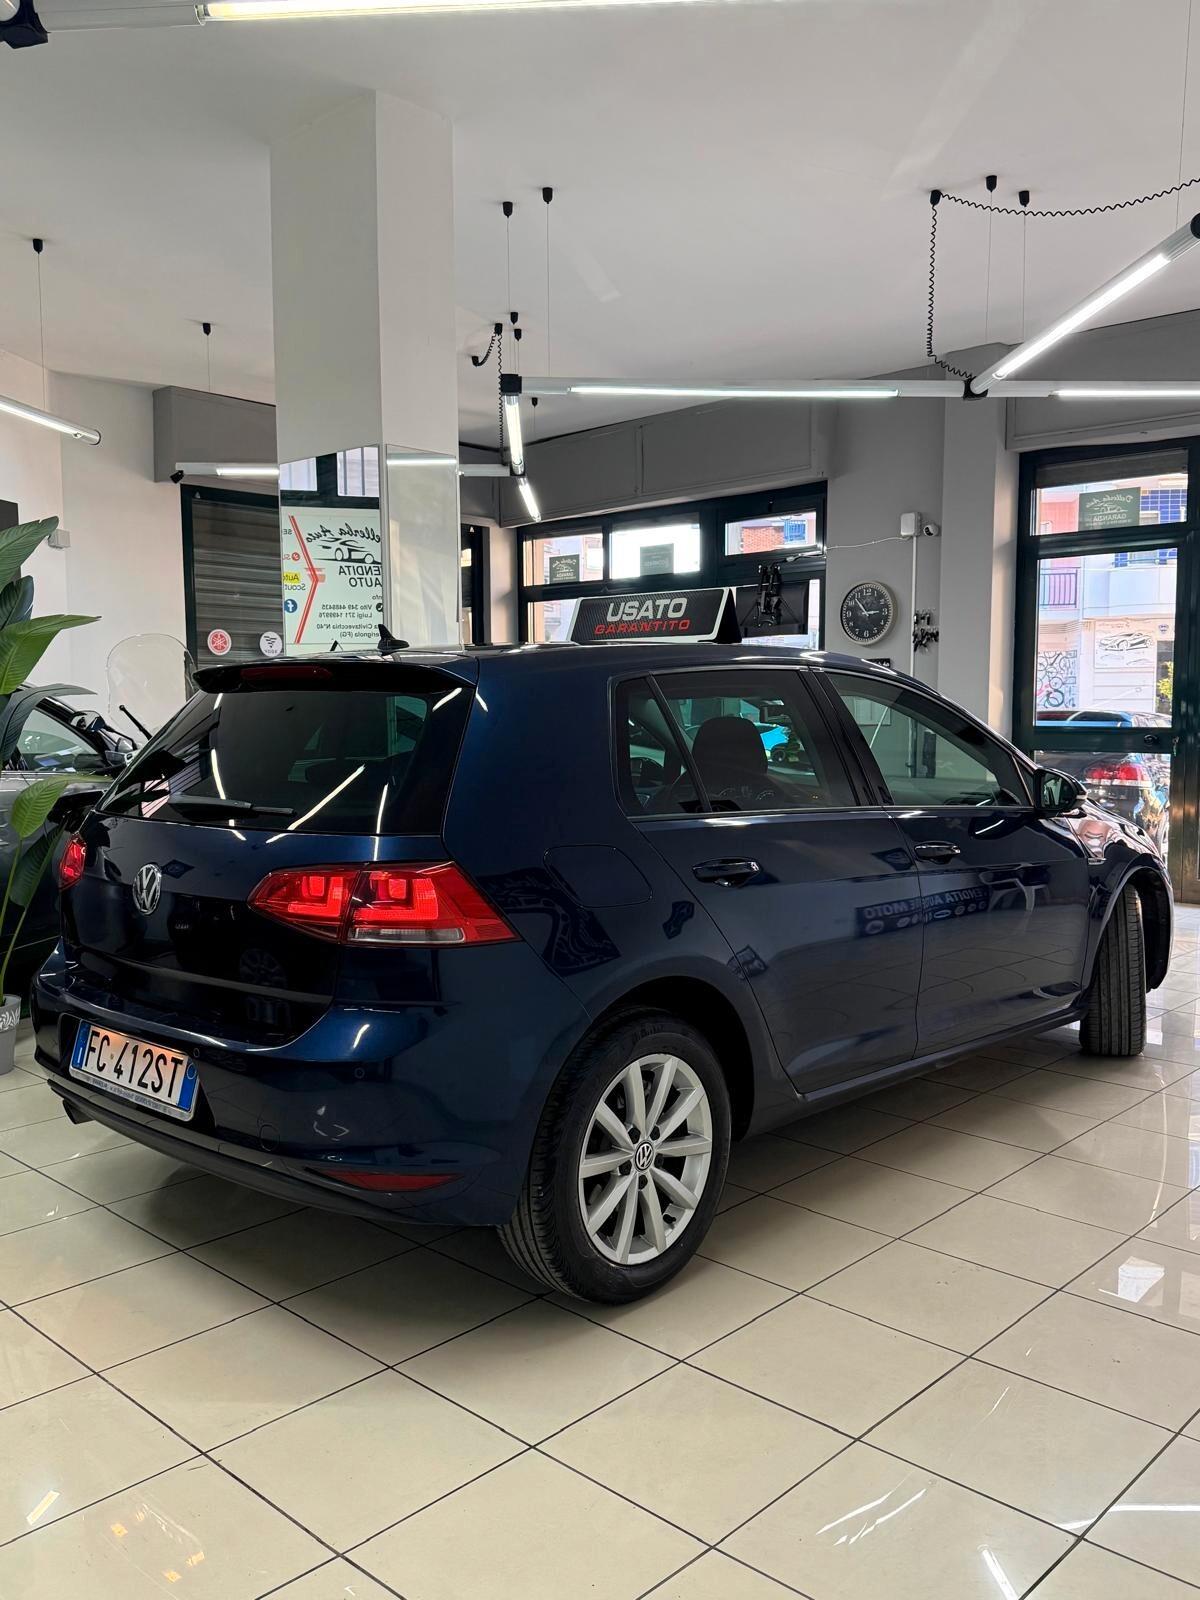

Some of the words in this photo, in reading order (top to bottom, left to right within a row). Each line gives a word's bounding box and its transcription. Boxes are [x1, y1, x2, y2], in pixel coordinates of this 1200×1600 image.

[606, 598, 688, 621] USATO
[594, 620, 690, 635] GARANTITO
[84, 1029, 111, 1073] FC
[113, 1041, 184, 1098] 412ST
